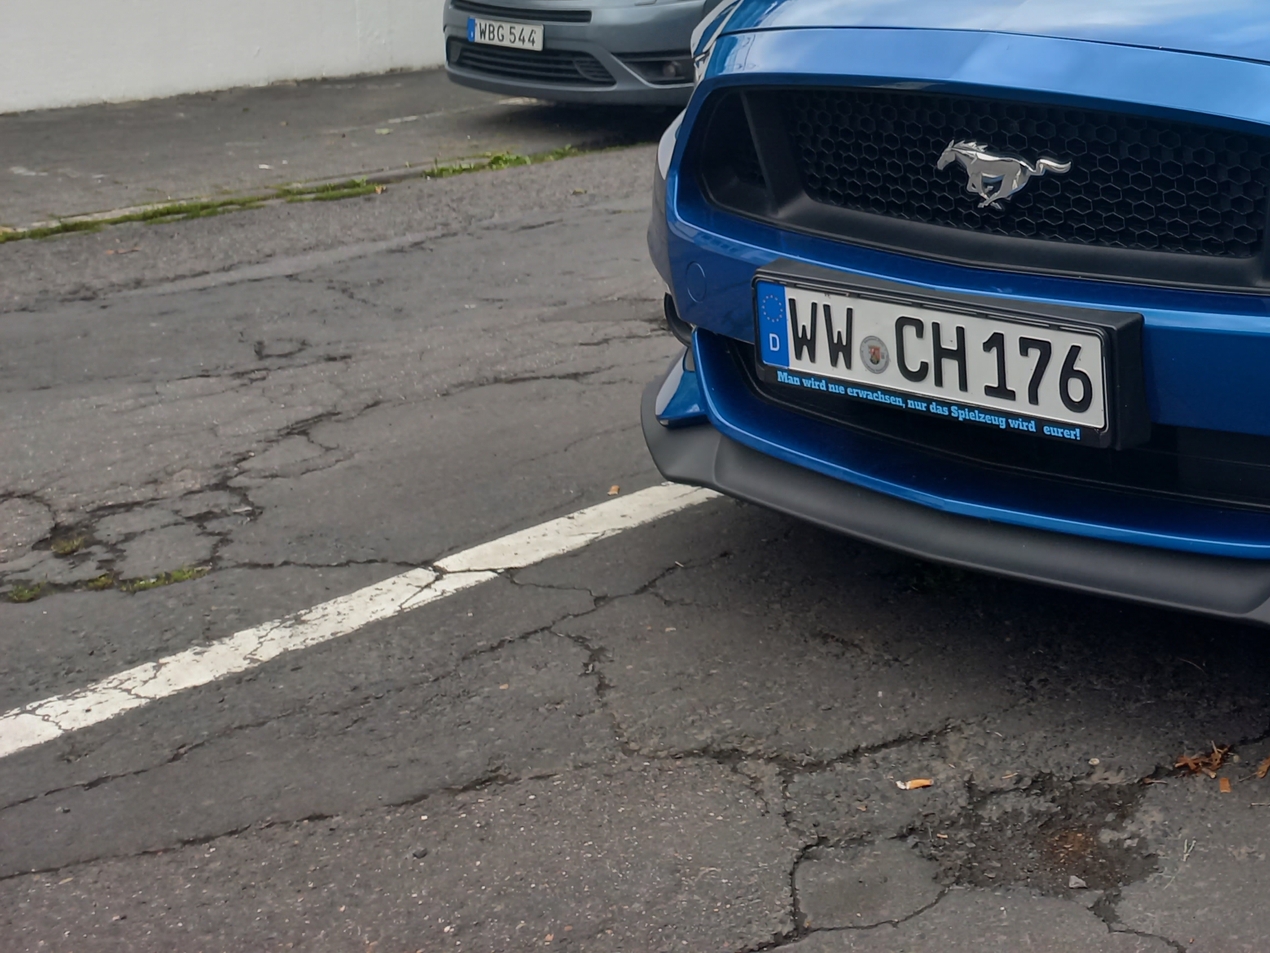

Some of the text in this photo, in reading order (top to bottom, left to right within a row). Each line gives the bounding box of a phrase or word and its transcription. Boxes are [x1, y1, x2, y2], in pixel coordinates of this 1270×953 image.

[479, 22, 536, 46] WBG 544
[769, 333, 780, 351] D
[788, 297, 854, 370] WW
[895, 315, 968, 392] CH
[981, 331, 1093, 413] 176
[777, 370, 800, 386] Man
[802, 377, 827, 391] wird
[847, 387, 906, 409] erwachsen,
[907, 399, 927, 411] nur
[929, 402, 949, 416] das
[951, 405, 1006, 429] Spielzeug
[1008, 418, 1036, 433] wird
[1043, 425, 1081, 441] eurer!
